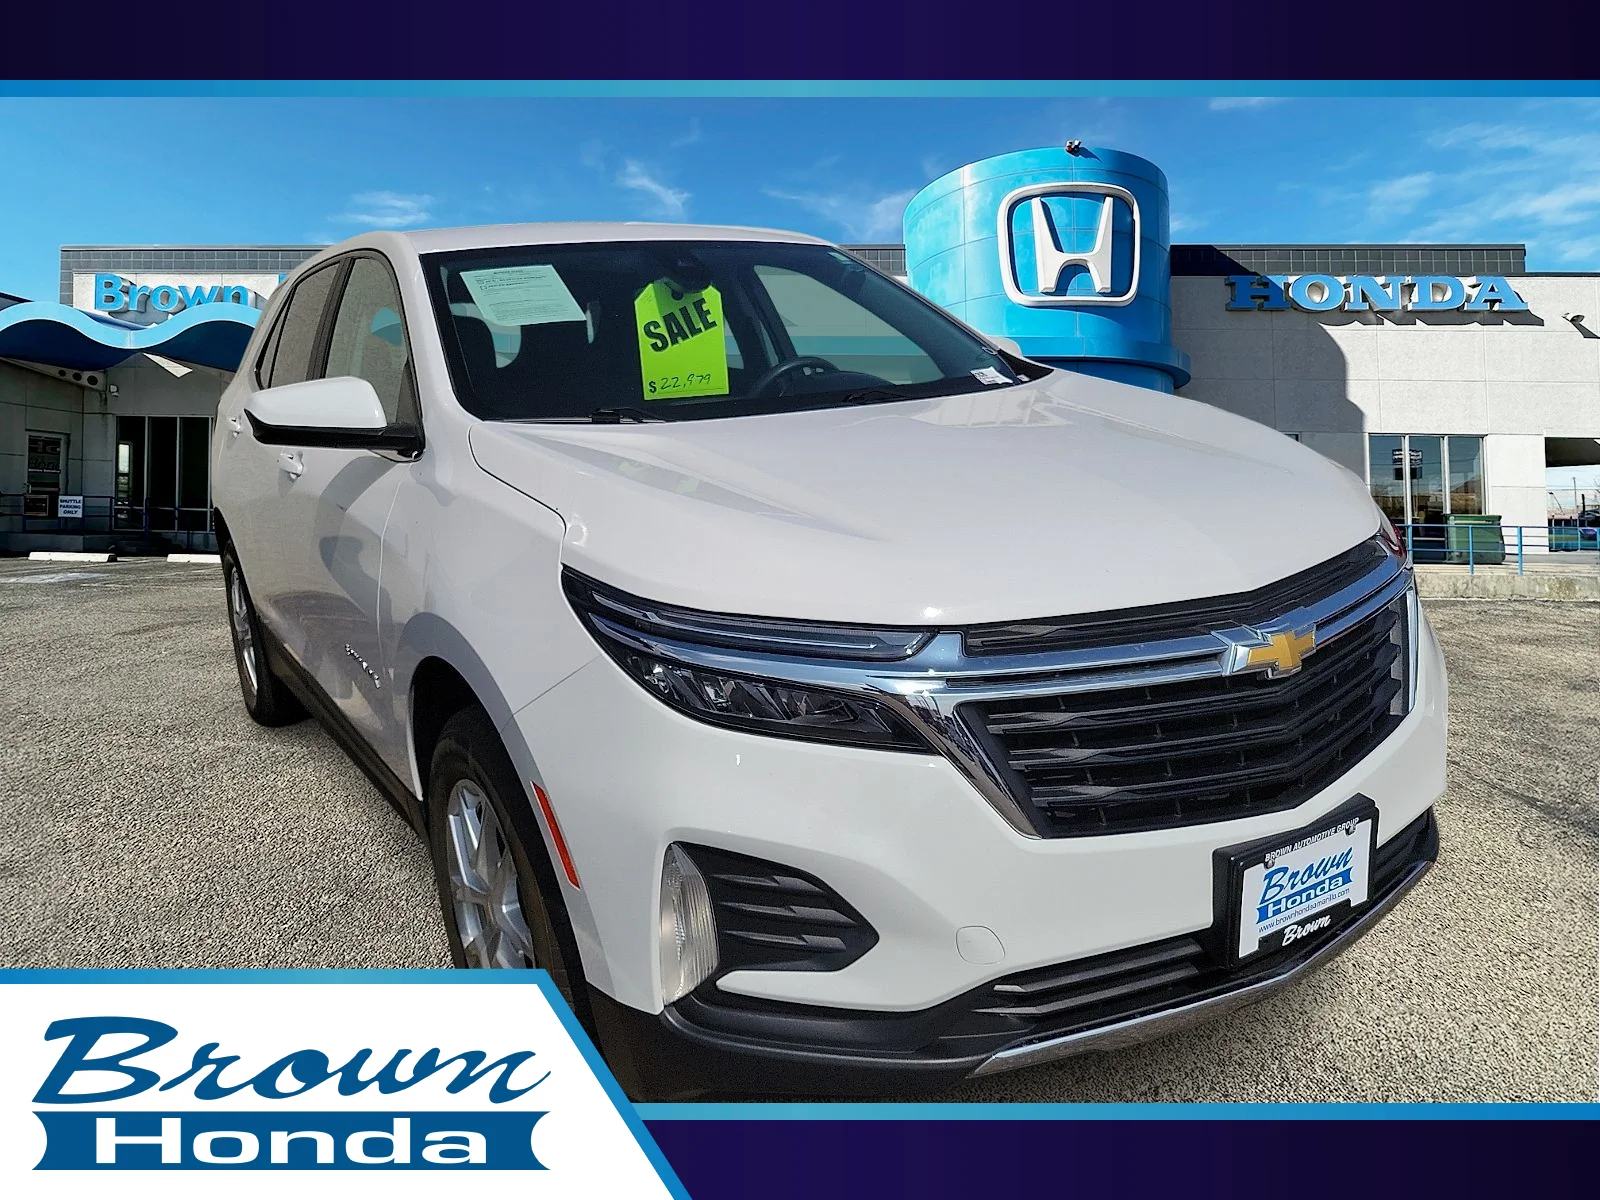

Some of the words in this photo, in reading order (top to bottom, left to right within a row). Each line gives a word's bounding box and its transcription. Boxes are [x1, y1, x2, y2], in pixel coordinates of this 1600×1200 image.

[94, 273, 249, 311] Brown
[1226, 274, 1529, 311] HONDA
[643, 297, 718, 352] SALE
[1264, 844, 1293, 861] BROWN
[1293, 826, 1337, 851] AUTOMOTIVE
[1336, 817, 1360, 833] GROUP
[1259, 846, 1353, 905] Brown
[1267, 875, 1343, 917] Honda
[1281, 914, 1332, 947] Brown
